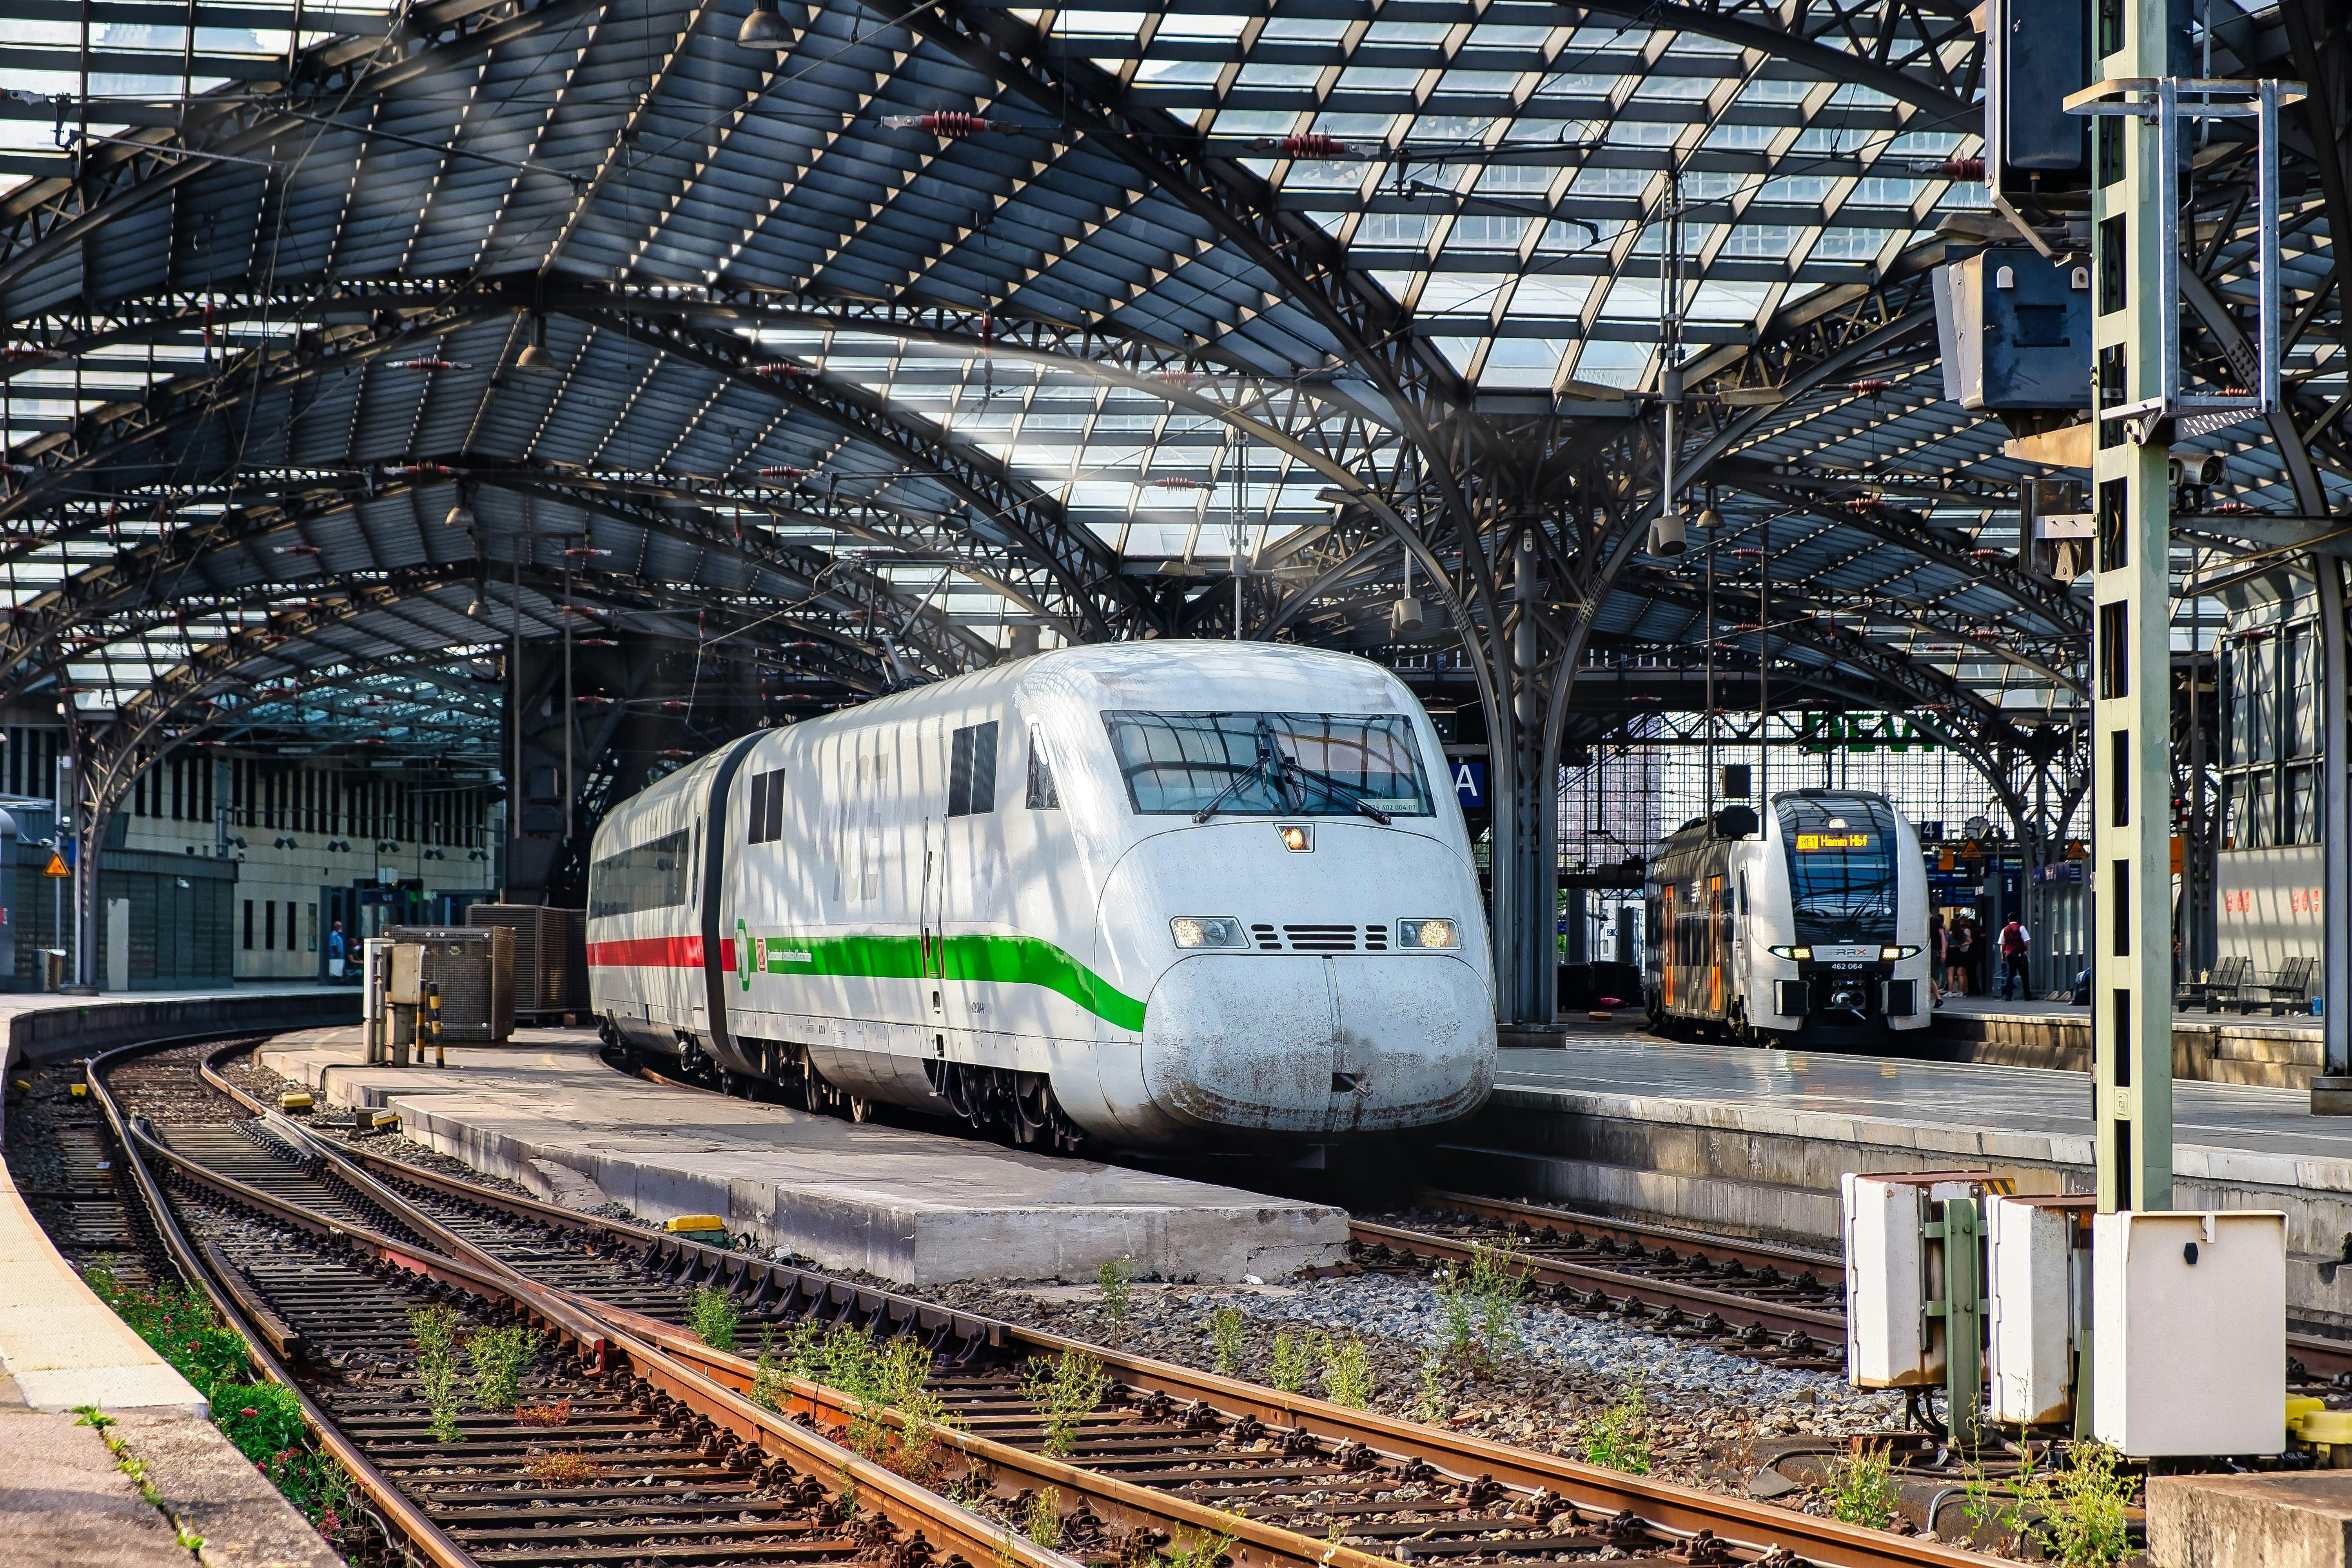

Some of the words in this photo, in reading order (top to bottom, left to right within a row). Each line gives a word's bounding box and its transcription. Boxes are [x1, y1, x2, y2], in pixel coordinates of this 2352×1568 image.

[1455, 765, 1477, 796] A
[833, 753, 889, 904] ICE
[1923, 822, 1935, 838] 4
[1801, 837, 1816, 848] RE1
[1820, 835, 1847, 847] Hamm
[1849, 835, 1867, 847] Hbf
